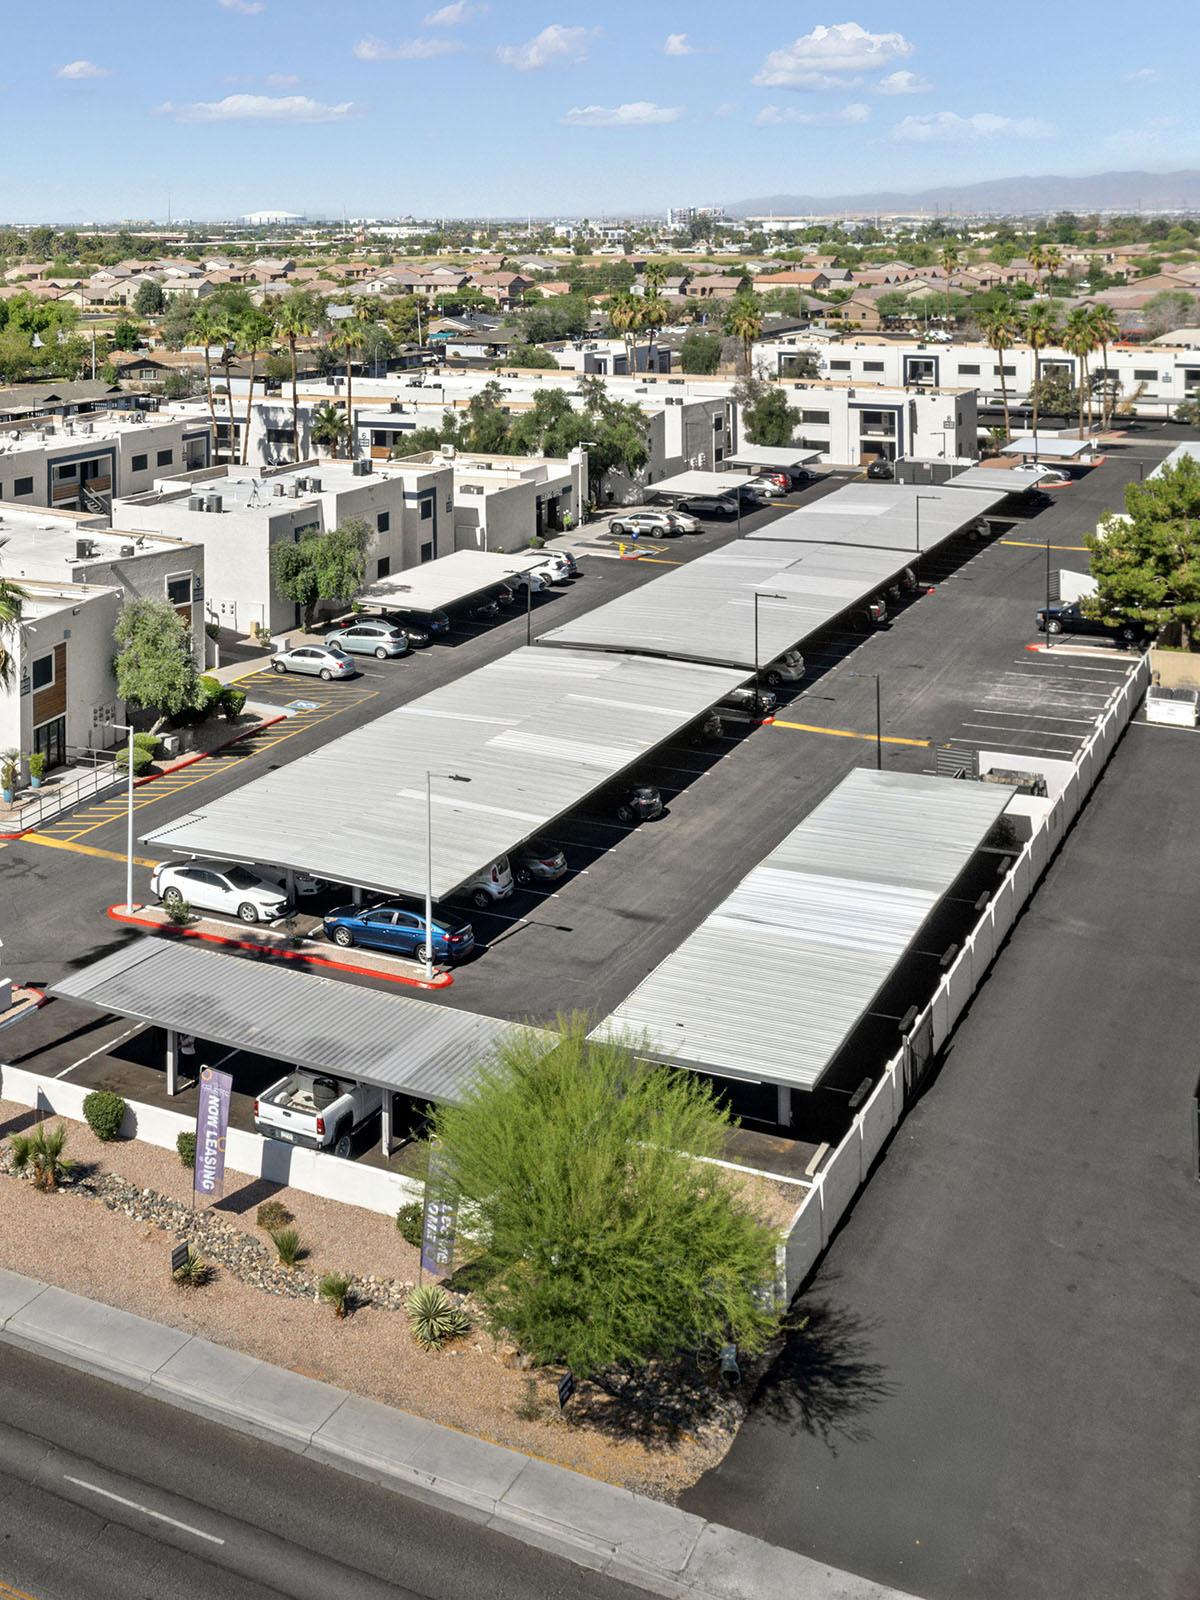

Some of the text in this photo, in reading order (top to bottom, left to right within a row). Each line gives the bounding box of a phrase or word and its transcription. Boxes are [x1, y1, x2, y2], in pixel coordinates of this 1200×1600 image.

[23, 665, 28, 678] 2
[207, 1094, 220, 1128] NOW
[202, 1130, 218, 1190] LEASING
